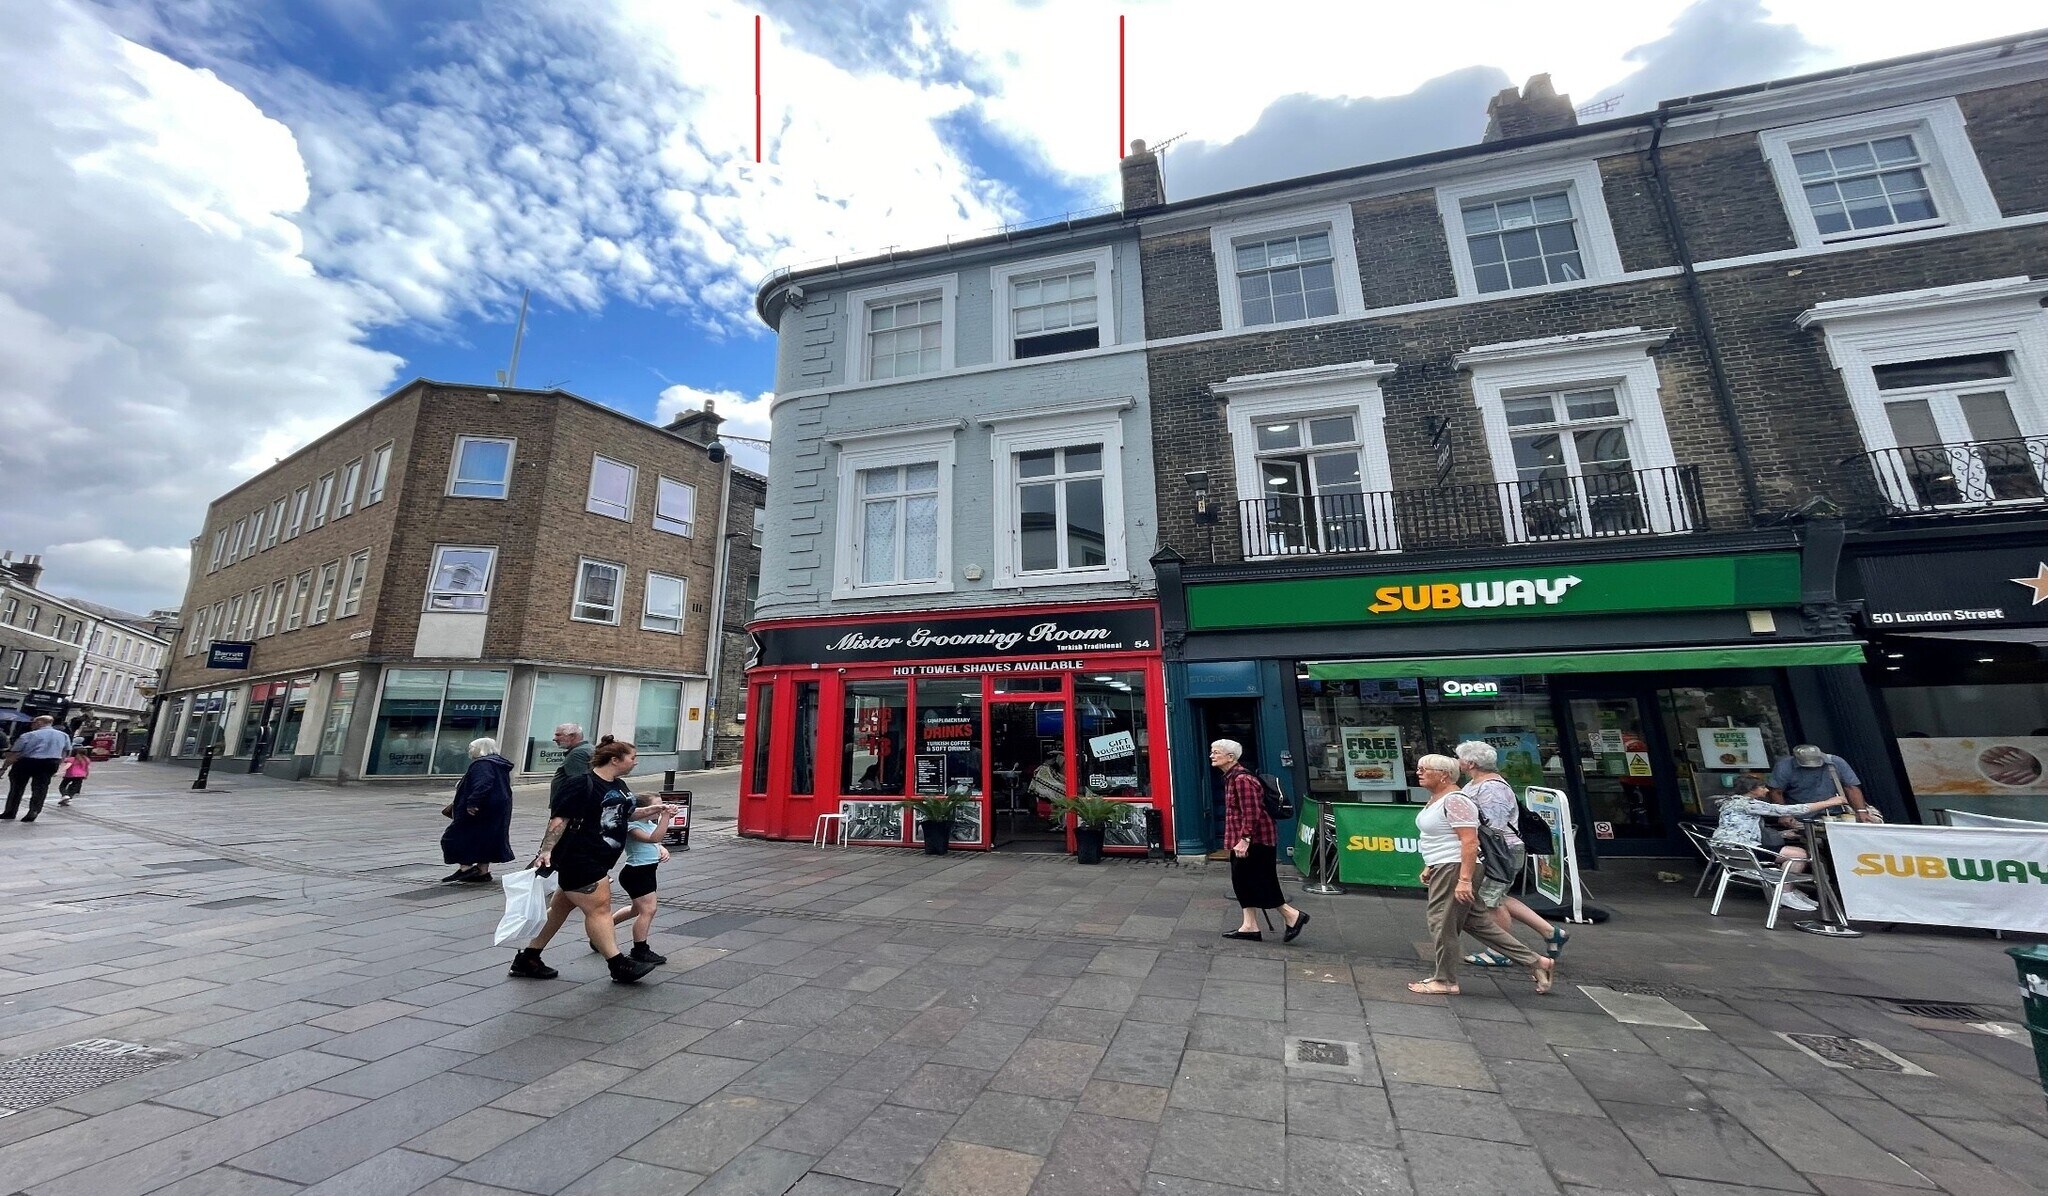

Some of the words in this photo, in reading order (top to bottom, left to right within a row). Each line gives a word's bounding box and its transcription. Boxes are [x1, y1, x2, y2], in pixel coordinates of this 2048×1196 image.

[1368, 575, 1583, 614] SUBWAY
[1872, 613, 1894, 624] 50
[1895, 611, 1952, 623] London
[1953, 608, 2004, 621] Street
[825, 632, 904, 651] Mister
[906, 627, 1024, 651] Grooming
[1026, 622, 1112, 642] Room
[1134, 640, 1150, 649] 54
[1084, 642, 1123, 650] Traditional
[893, 666, 915, 676] HOT
[916, 665, 960, 675] TOWEL
[962, 662, 1012, 673] SHAVES
[1014, 660, 1084, 671] AVAILABLE
[1442, 680, 1498, 696] Open
[923, 724, 973, 740] DRINKS
[1096, 744, 1132, 755] VOUCHER
[1108, 737, 1129, 748] GIFT
[1346, 738, 1398, 749] FREE
[1365, 750, 1399, 759] SUB
[1346, 835, 1421, 853] SUBW
